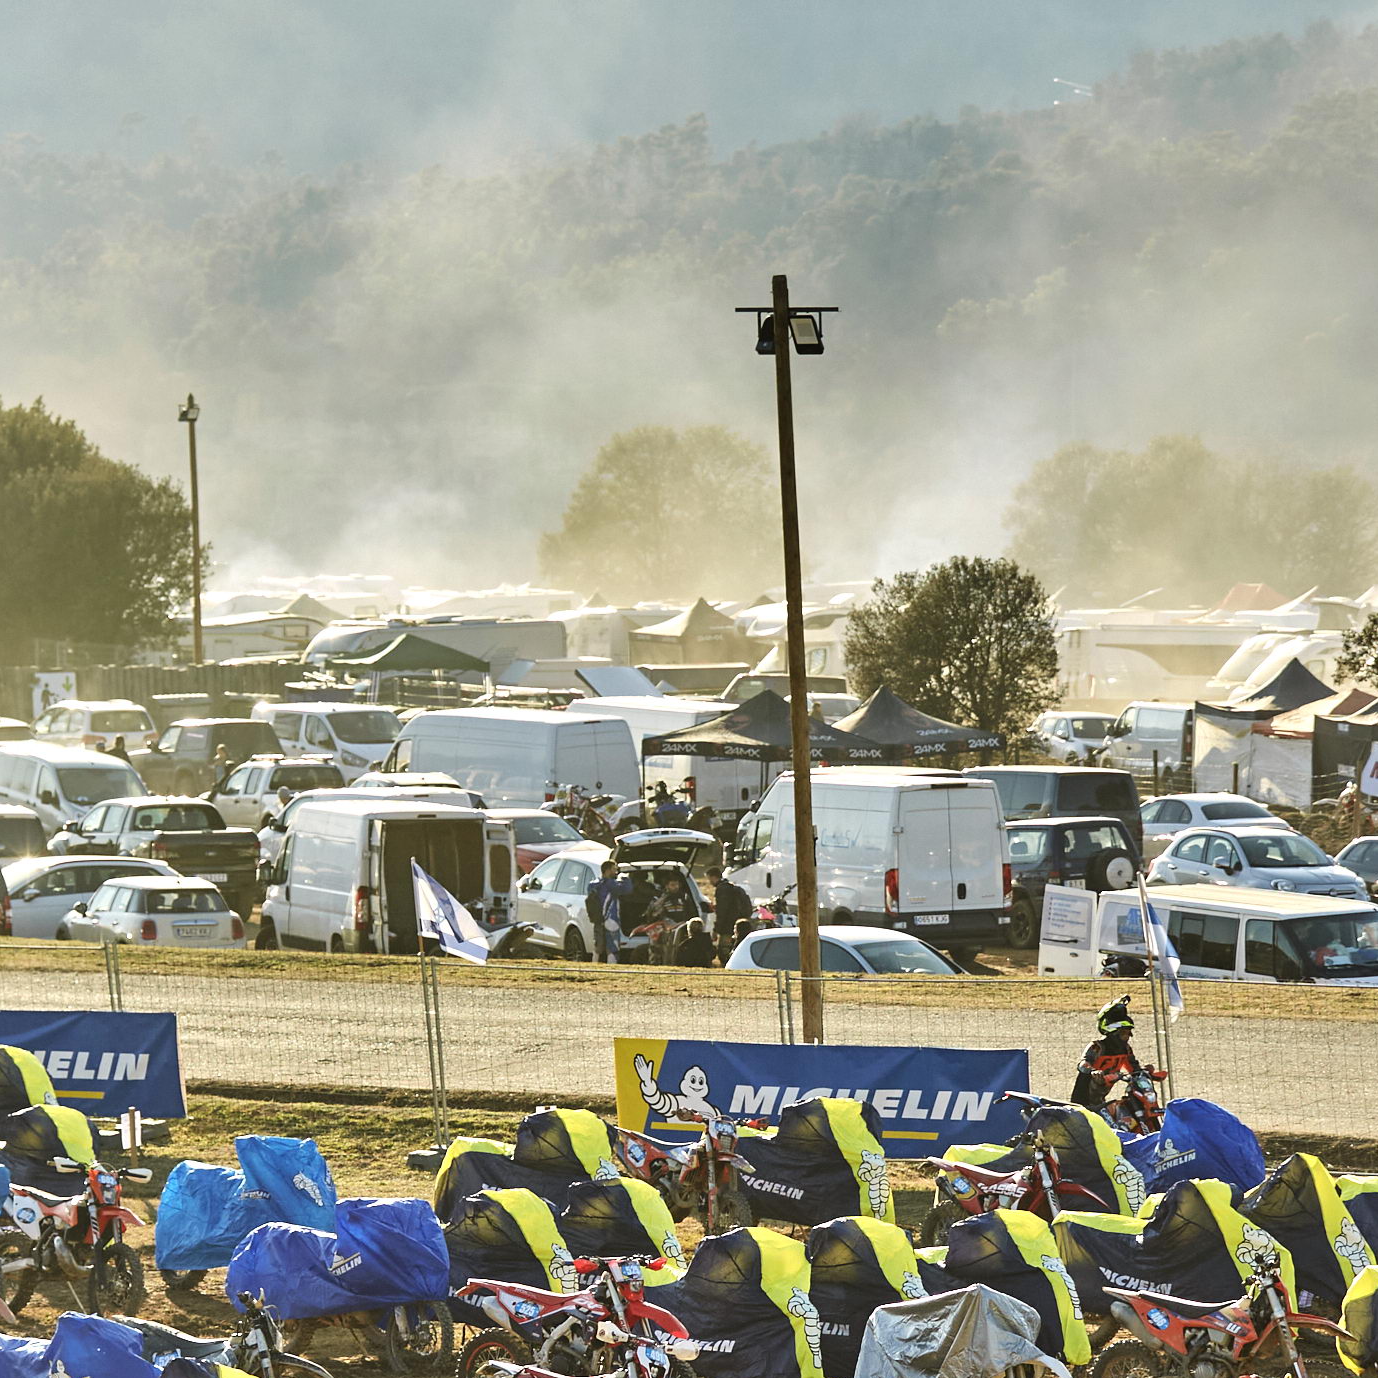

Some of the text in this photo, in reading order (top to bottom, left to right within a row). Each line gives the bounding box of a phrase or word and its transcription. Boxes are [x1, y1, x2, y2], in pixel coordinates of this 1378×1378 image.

[662, 742, 698, 753] 24MX
[968, 737, 1000, 748] 24MX
[724, 745, 761, 758] 24MX
[849, 748, 882, 759] 24MX
[914, 743, 947, 755] 24MX
[519, 1304, 536, 1317] 525
